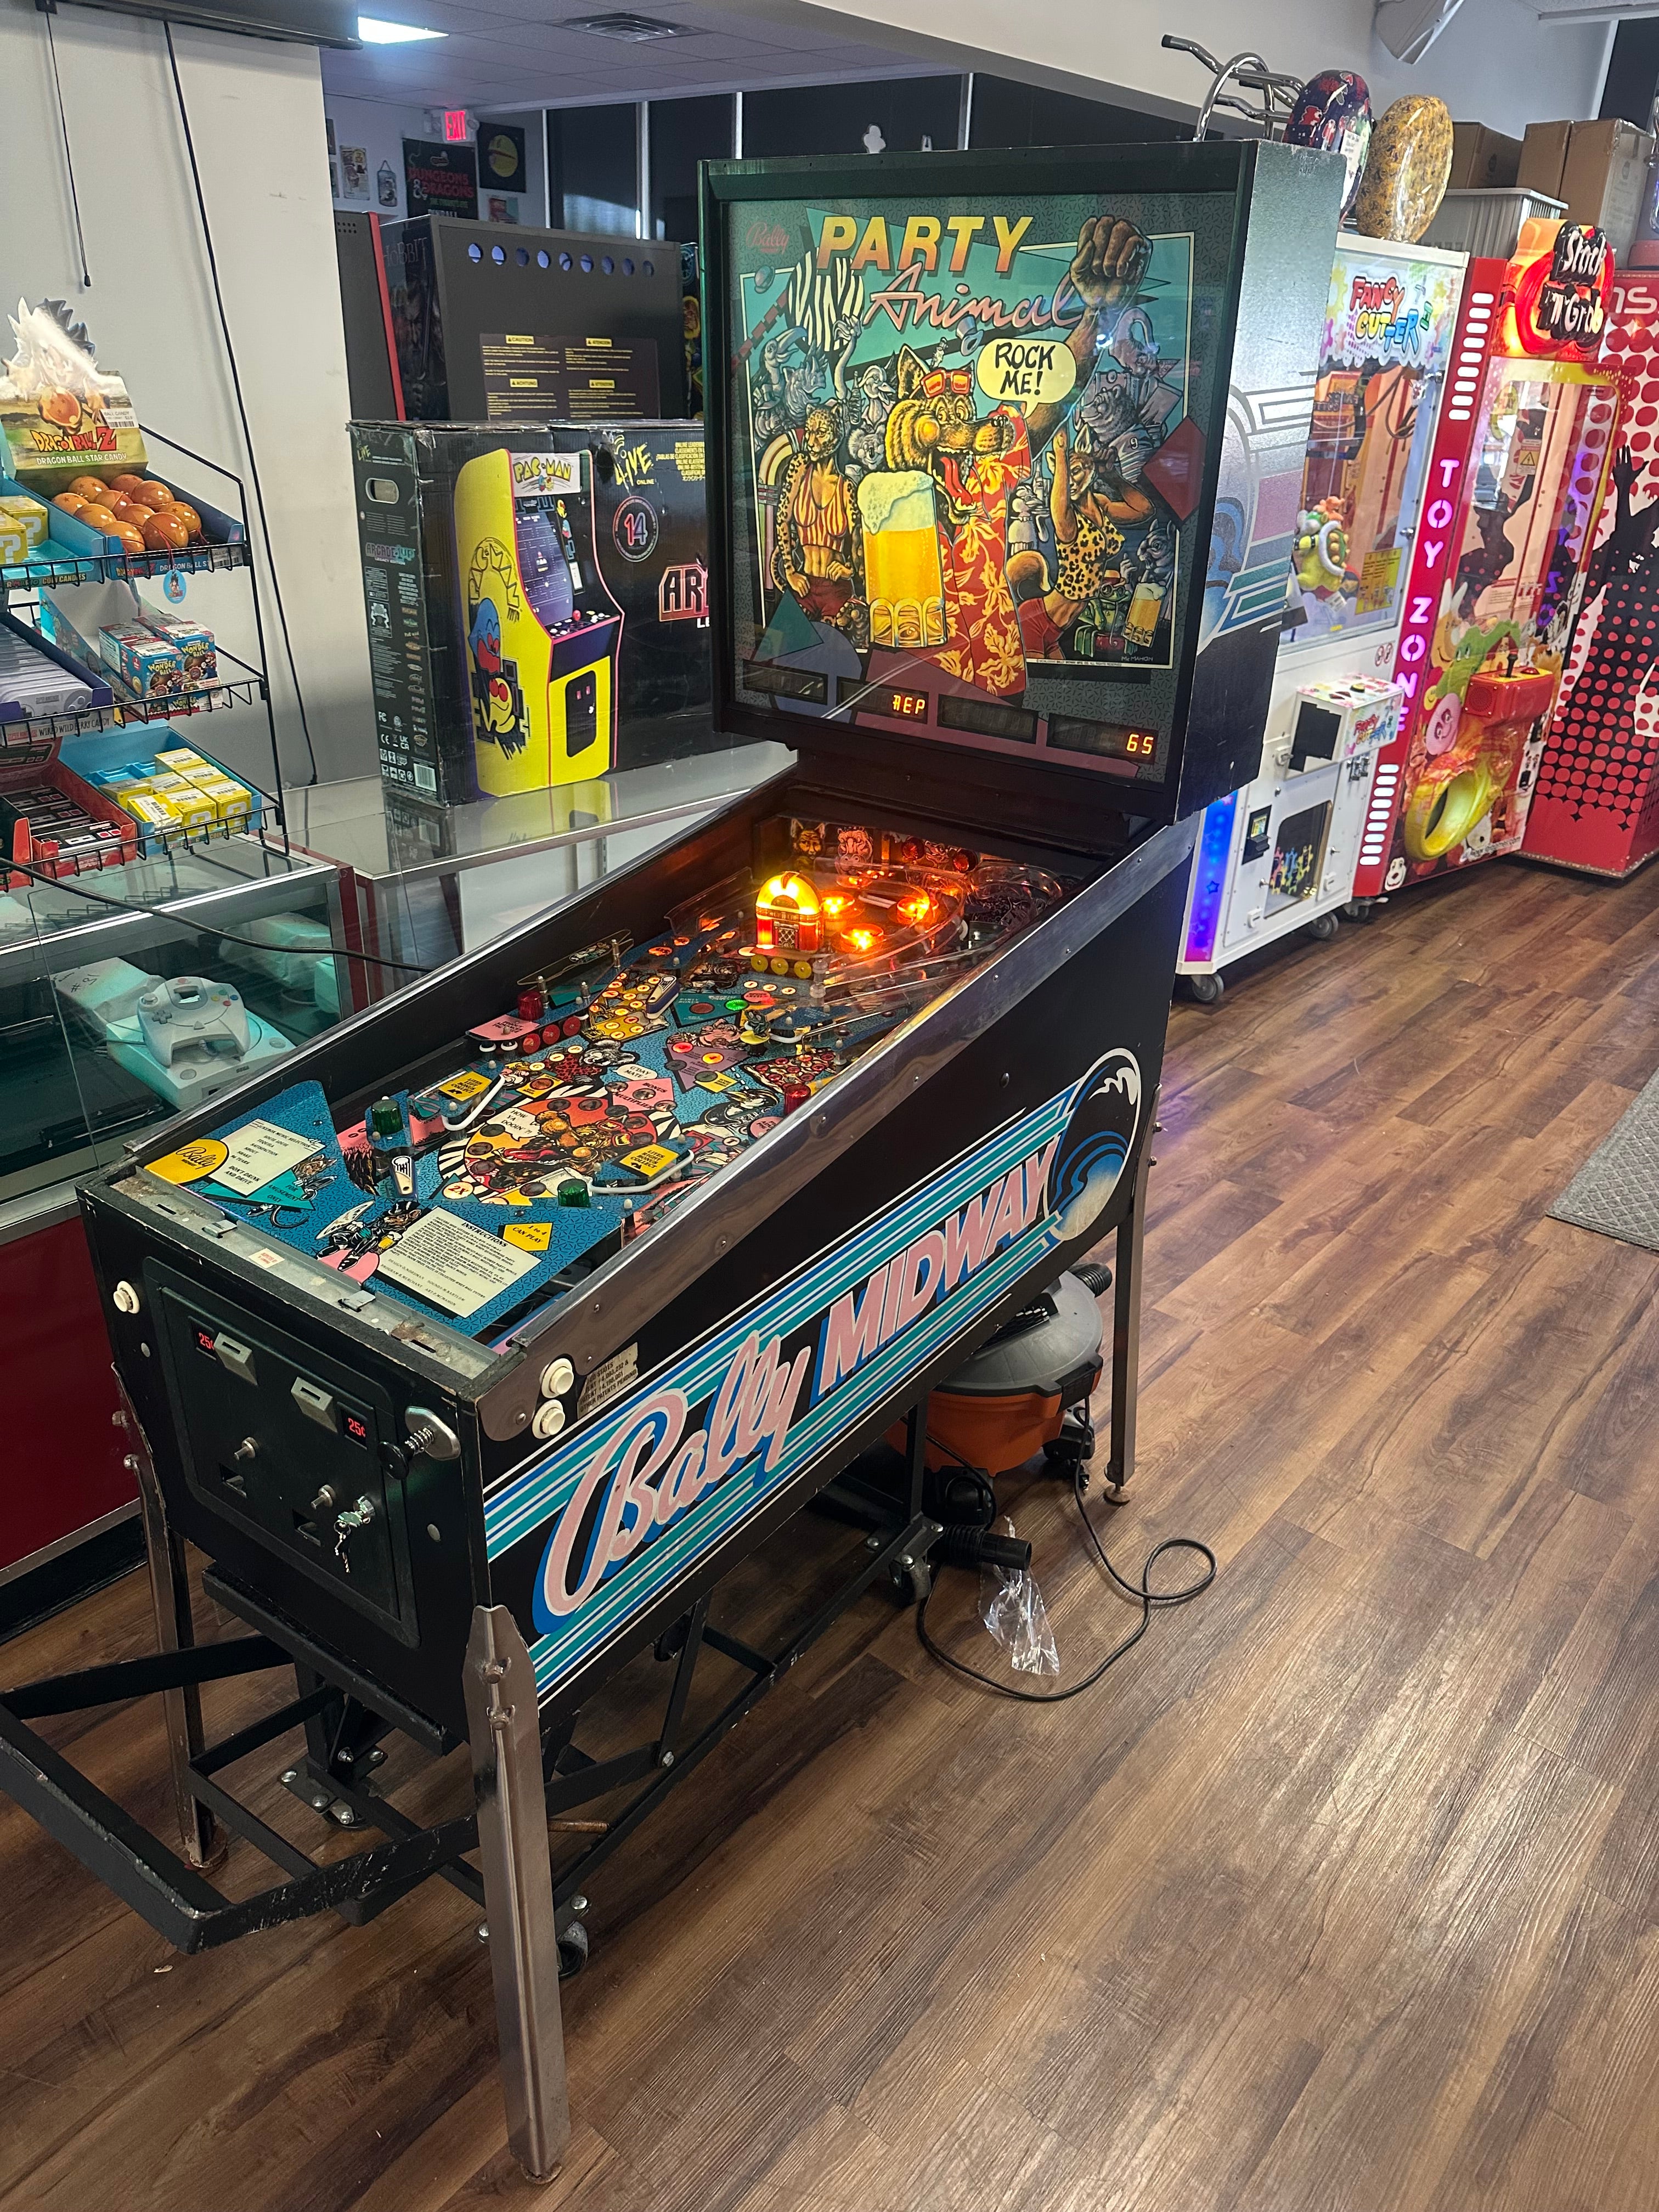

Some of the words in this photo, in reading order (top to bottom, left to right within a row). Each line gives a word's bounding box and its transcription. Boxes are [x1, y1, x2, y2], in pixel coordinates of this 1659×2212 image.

[445, 111, 466, 140] EXIT
[407, 167, 470, 185] DUNGEONS
[413, 178, 427, 200] &
[425, 182, 474, 198] DRAGONS
[746, 220, 789, 255] Bally
[817, 216, 1034, 274] PARTY
[863, 261, 1084, 330] Animal
[1350, 276, 1405, 324] FANCY
[1355, 308, 1419, 354] CUTTER
[995, 345, 1054, 371] ROCK
[999, 370, 1041, 396] ME!
[30, 430, 75, 452] DRAGON
[71, 431, 97, 451] BALL
[96, 426, 116, 452] Z
[36, 457, 66, 465] DRAGON
[67, 455, 84, 463] BALL
[84, 454, 103, 462] STAR
[104, 453, 127, 461] CANDY
[513, 456, 571, 483] PAC-MAN
[624, 512, 648, 545] 14
[181, 642, 209, 654] WONDER
[148, 660, 176, 672] WONDER
[381, 735, 390, 744] CE
[400, 735, 408, 744] UK
[400, 742, 409, 751] CA
[1126, 732, 1154, 754] 65
[642, 1082, 668, 1093] BONUS
[614, 1092, 654, 1109] MULTIPLIER
[511, 1110, 527, 1118] HOW
[287, 1137, 312, 1148] SELECTION
[176, 1146, 216, 1170] Bally
[644, 1152, 662, 1161] RIGHT
[647, 1149, 664, 1158] LITES
[630, 1156, 658, 1169] COLLECT
[234, 1175, 253, 1184] DRIVE
[242, 1172, 261, 1182] DRINK
[268, 1184, 300, 1201] AMUSEMENT
[285, 1183, 298, 1193] FOR
[448, 1185, 470, 1195] 2X
[267, 1194, 281, 1203] ONLY
[461, 1221, 507, 1248] INSTRUCTIONS
[512, 1227, 526, 1235] CAN
[526, 1234, 543, 1243] PLAY
[811, 1141, 1058, 1409] MIDWAY
[199, 1333, 215, 1350] 25¢
[597, 1362, 613, 1377] STATES
[580, 1400, 596, 1412] OTHER
[597, 1385, 616, 1400] PATENTS
[617, 1369, 636, 1385] PENDING
[348, 1418, 365, 1437] 25¢
[530, 1329, 812, 1634] Bally
